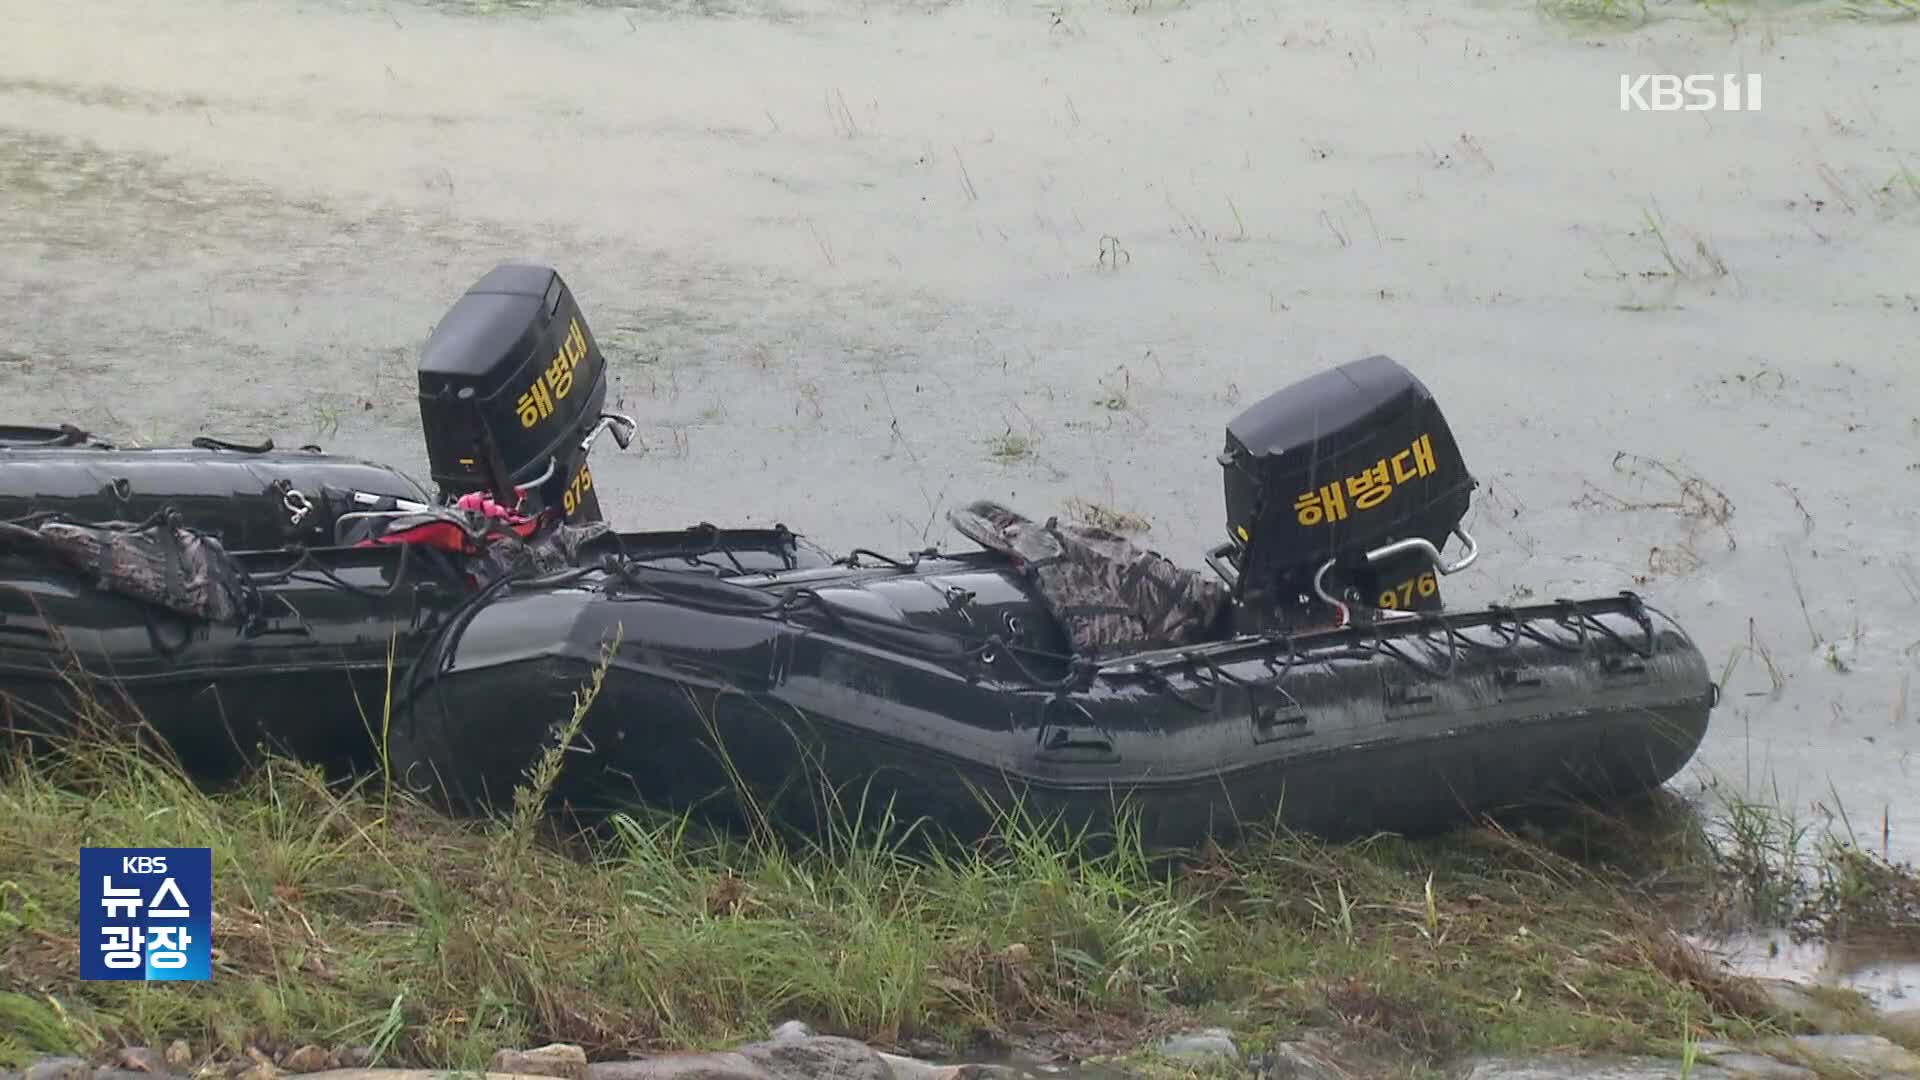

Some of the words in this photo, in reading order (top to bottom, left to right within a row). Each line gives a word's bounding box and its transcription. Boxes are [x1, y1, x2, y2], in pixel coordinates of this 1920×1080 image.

[515, 317, 588, 428] 해병대
[563, 464, 593, 516] 975
[1294, 432, 1437, 526] 해병대
[1379, 571, 1436, 609] 976
